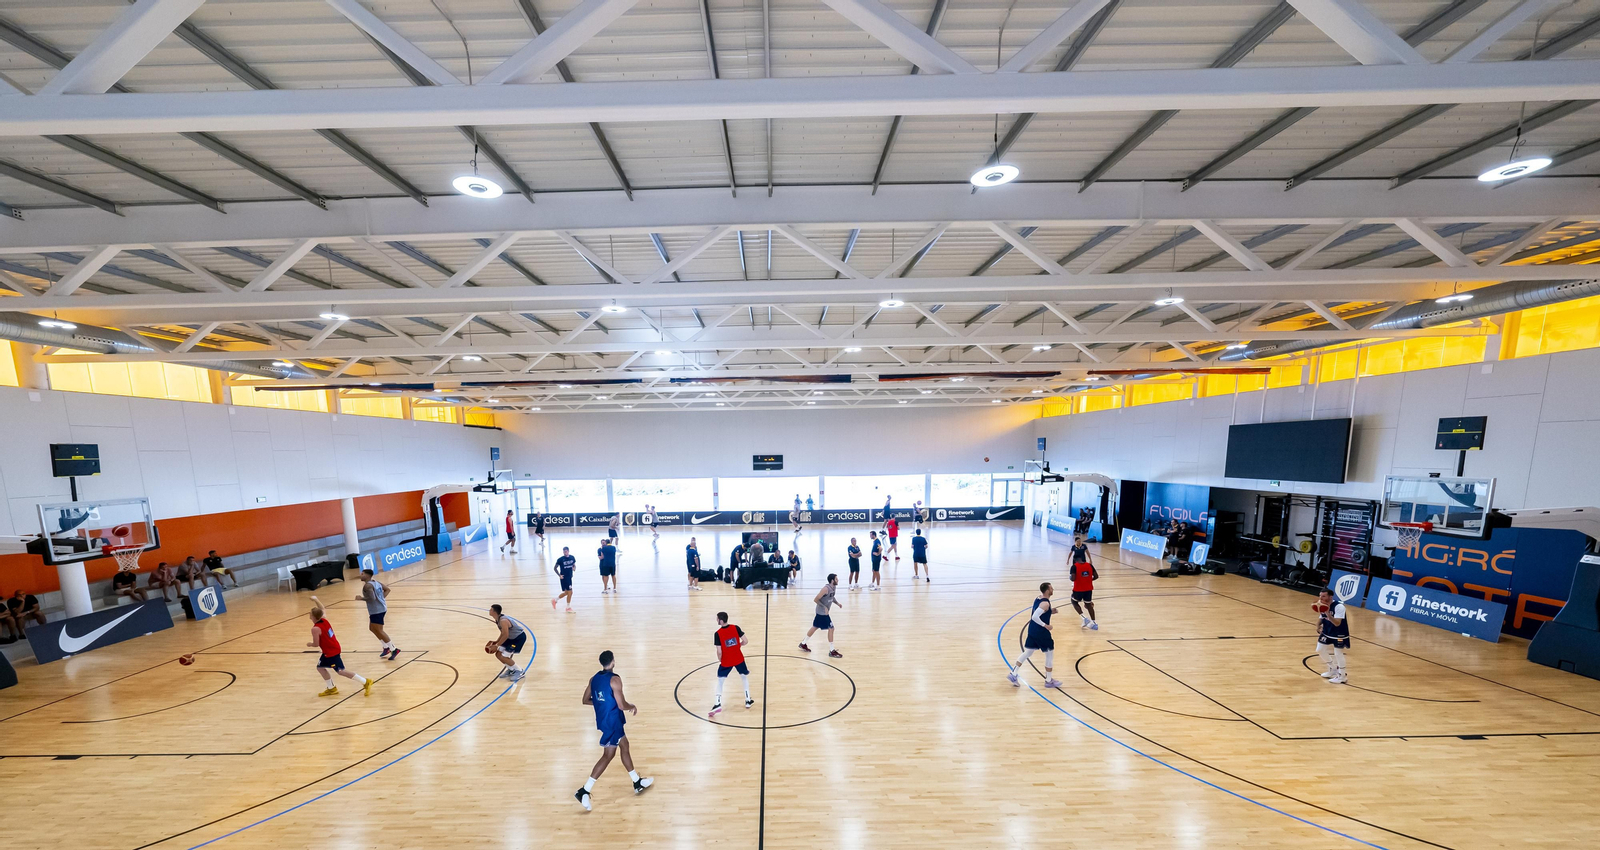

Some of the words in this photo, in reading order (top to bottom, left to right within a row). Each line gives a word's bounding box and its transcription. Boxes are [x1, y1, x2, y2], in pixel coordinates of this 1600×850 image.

[531, 514, 570, 524] edesa
[827, 511, 866, 520] endesa
[1133, 536, 1159, 551] CaixaBank
[385, 546, 423, 565] endesa
[1340, 580, 1355, 597] 100
[201, 593, 215, 611] 100
[1411, 594, 1488, 623] finetwork
[1409, 607, 1430, 617] FIBRA
[1436, 612, 1458, 624] MÓVIL
